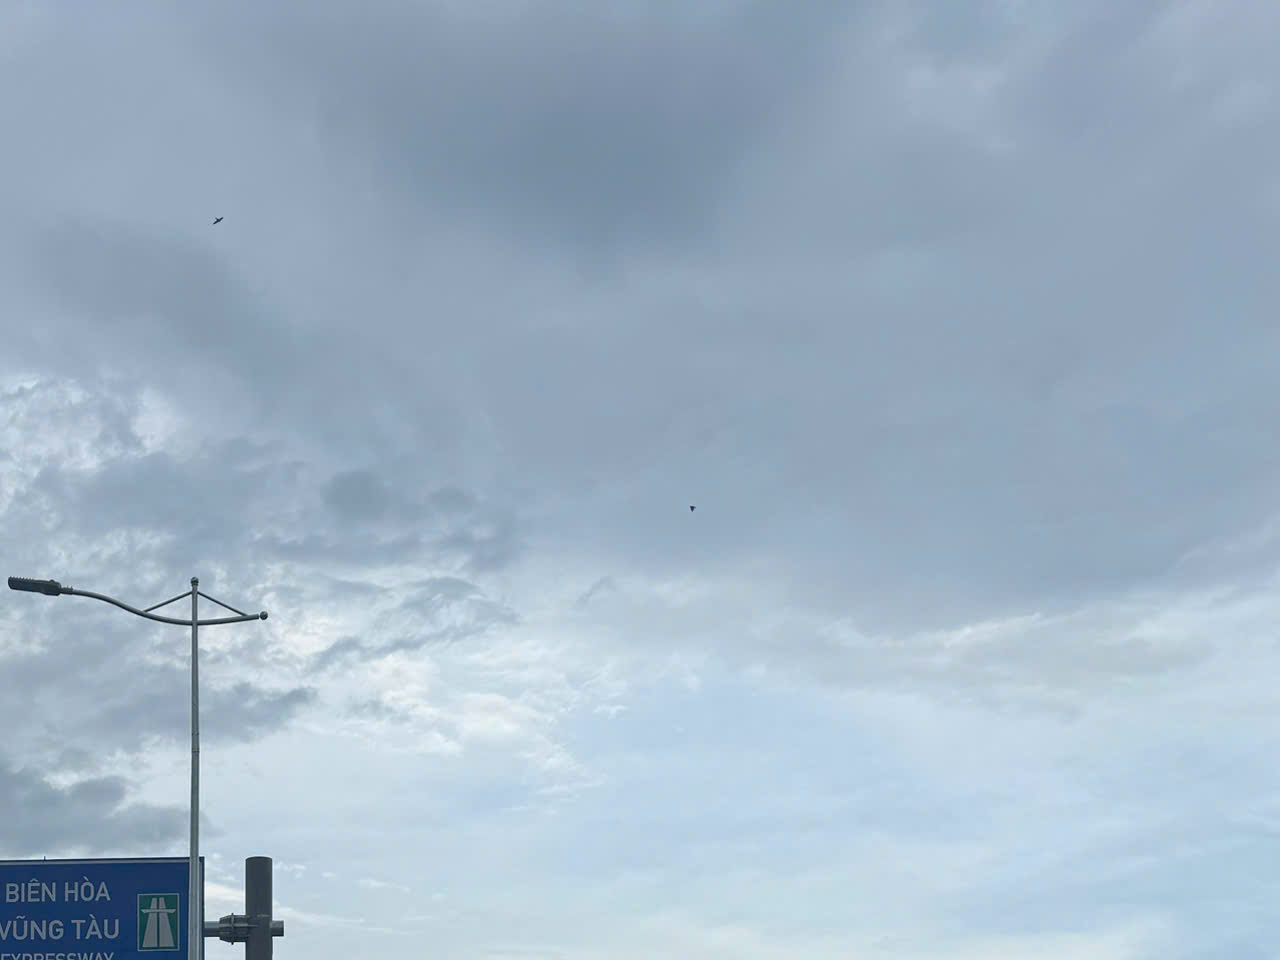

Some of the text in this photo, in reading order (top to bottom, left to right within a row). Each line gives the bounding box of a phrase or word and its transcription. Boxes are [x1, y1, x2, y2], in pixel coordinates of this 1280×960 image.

[5, 876, 111, 903] BIÊN HÒA
[71, 914, 120, 939] TÀU
